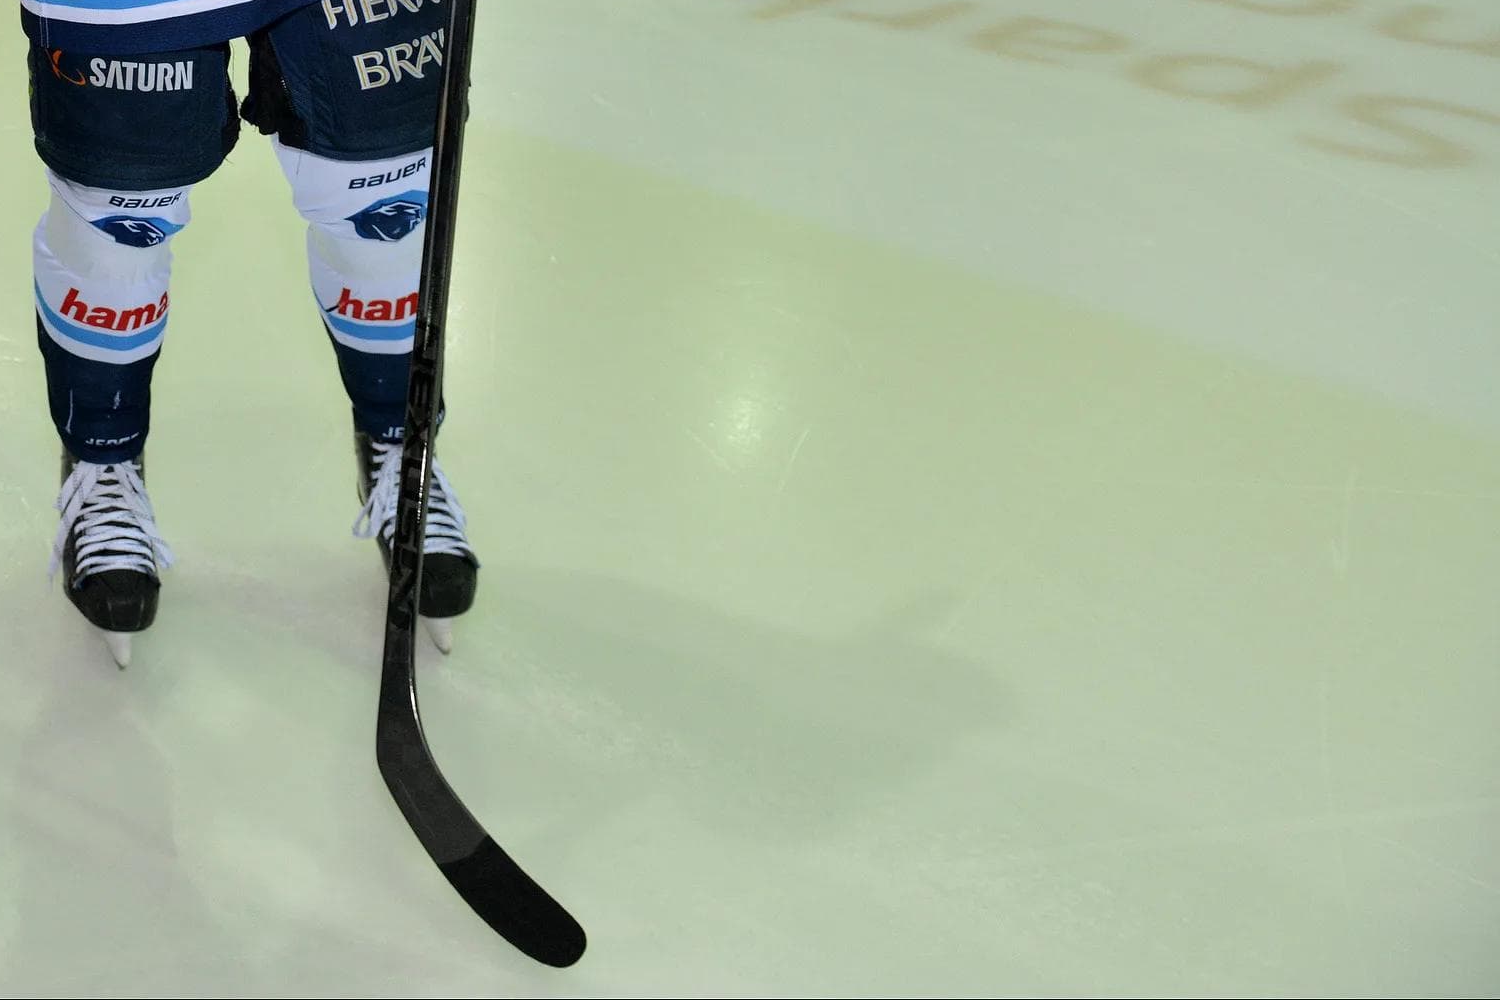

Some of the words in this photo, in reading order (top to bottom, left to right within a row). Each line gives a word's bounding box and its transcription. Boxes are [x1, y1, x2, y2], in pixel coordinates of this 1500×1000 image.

[89, 57, 194, 92] SATURN
[352, 28, 444, 91] BRÄ
[348, 157, 426, 189] BAUER
[109, 191, 182, 209] BAUER
[59, 287, 169, 331] hama
